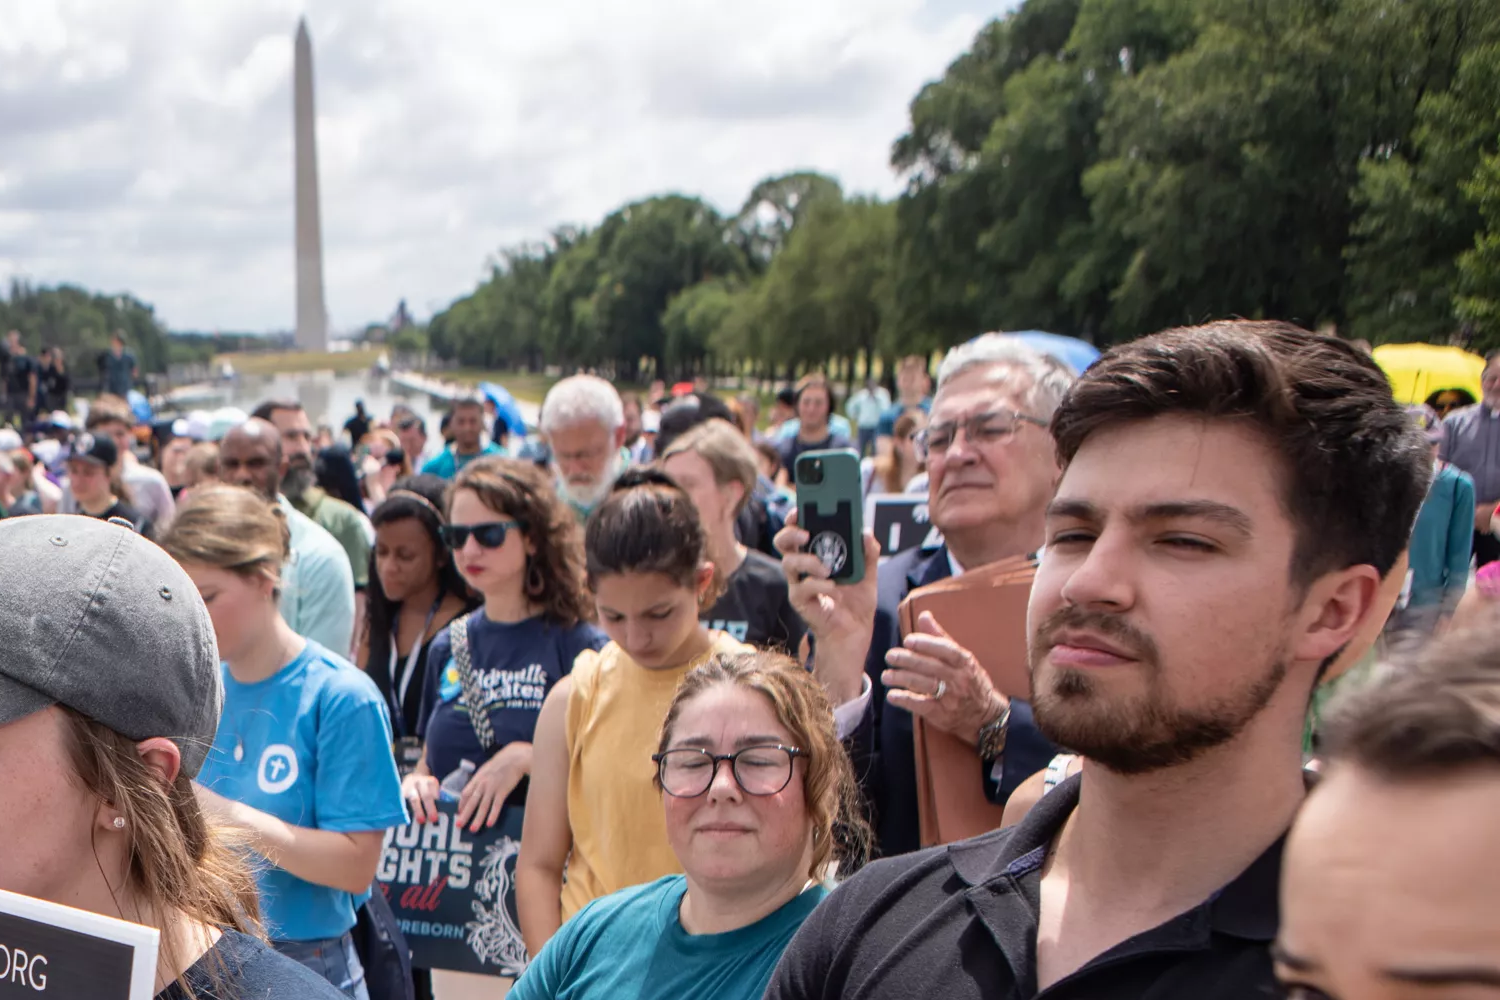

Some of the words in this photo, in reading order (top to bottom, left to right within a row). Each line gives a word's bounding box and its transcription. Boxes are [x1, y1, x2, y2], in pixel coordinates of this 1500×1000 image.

[383, 812, 473, 853] UAL
[376, 847, 472, 889] GHTS
[400, 875, 450, 911] all
[397, 918, 465, 939] REBORN
